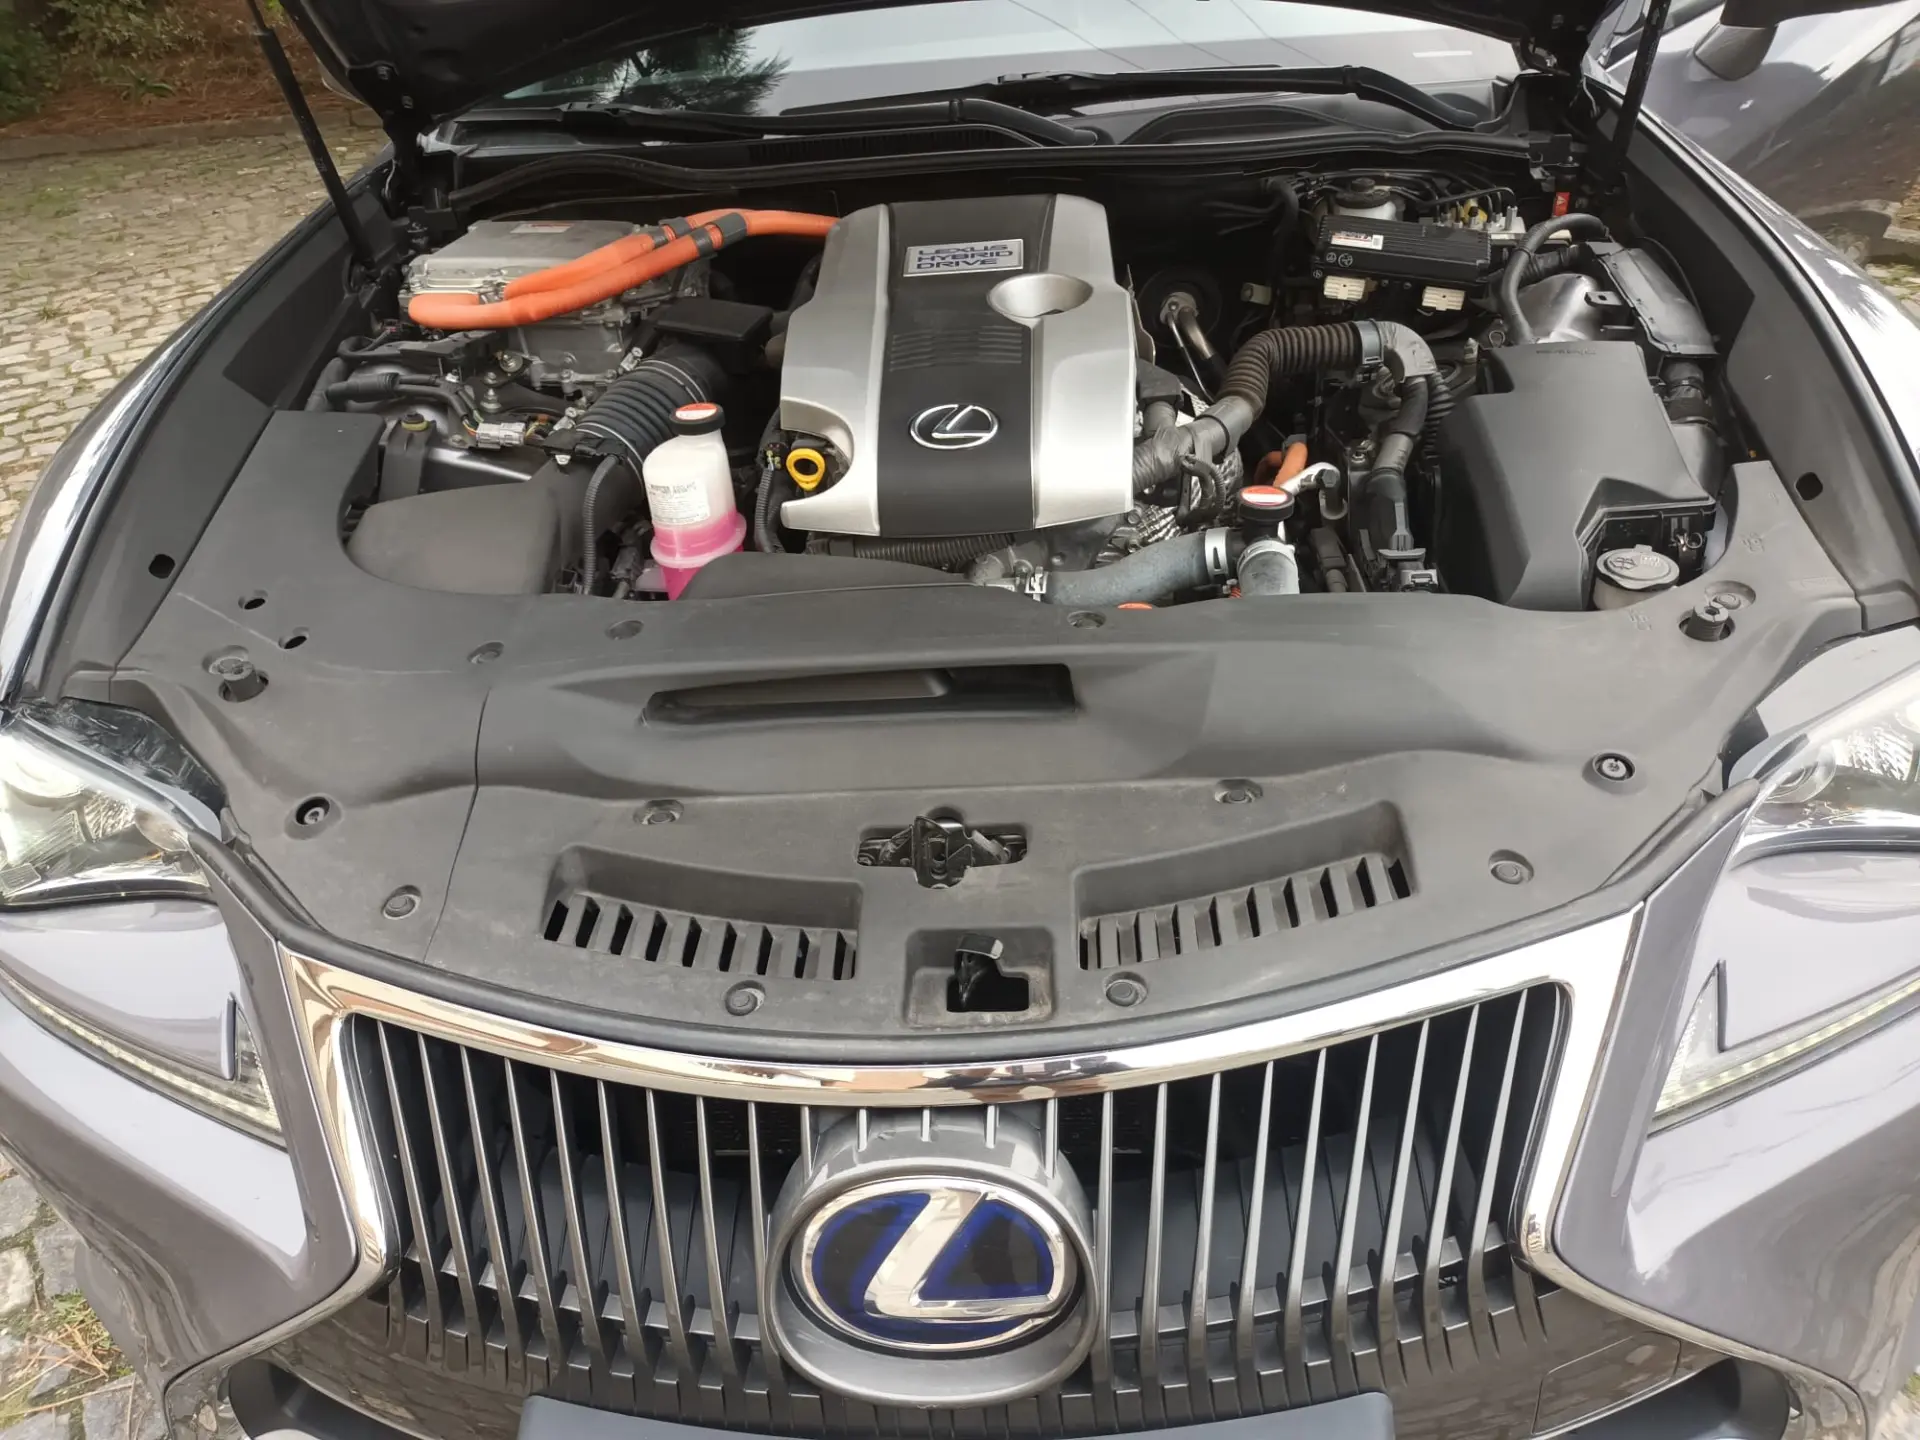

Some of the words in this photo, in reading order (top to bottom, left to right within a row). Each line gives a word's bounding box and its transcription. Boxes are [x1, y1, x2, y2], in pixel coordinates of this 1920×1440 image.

[917, 250, 1013, 262] HYBRID
[919, 244, 1009, 256] LEXUS
[916, 258, 998, 269] DRIVE
